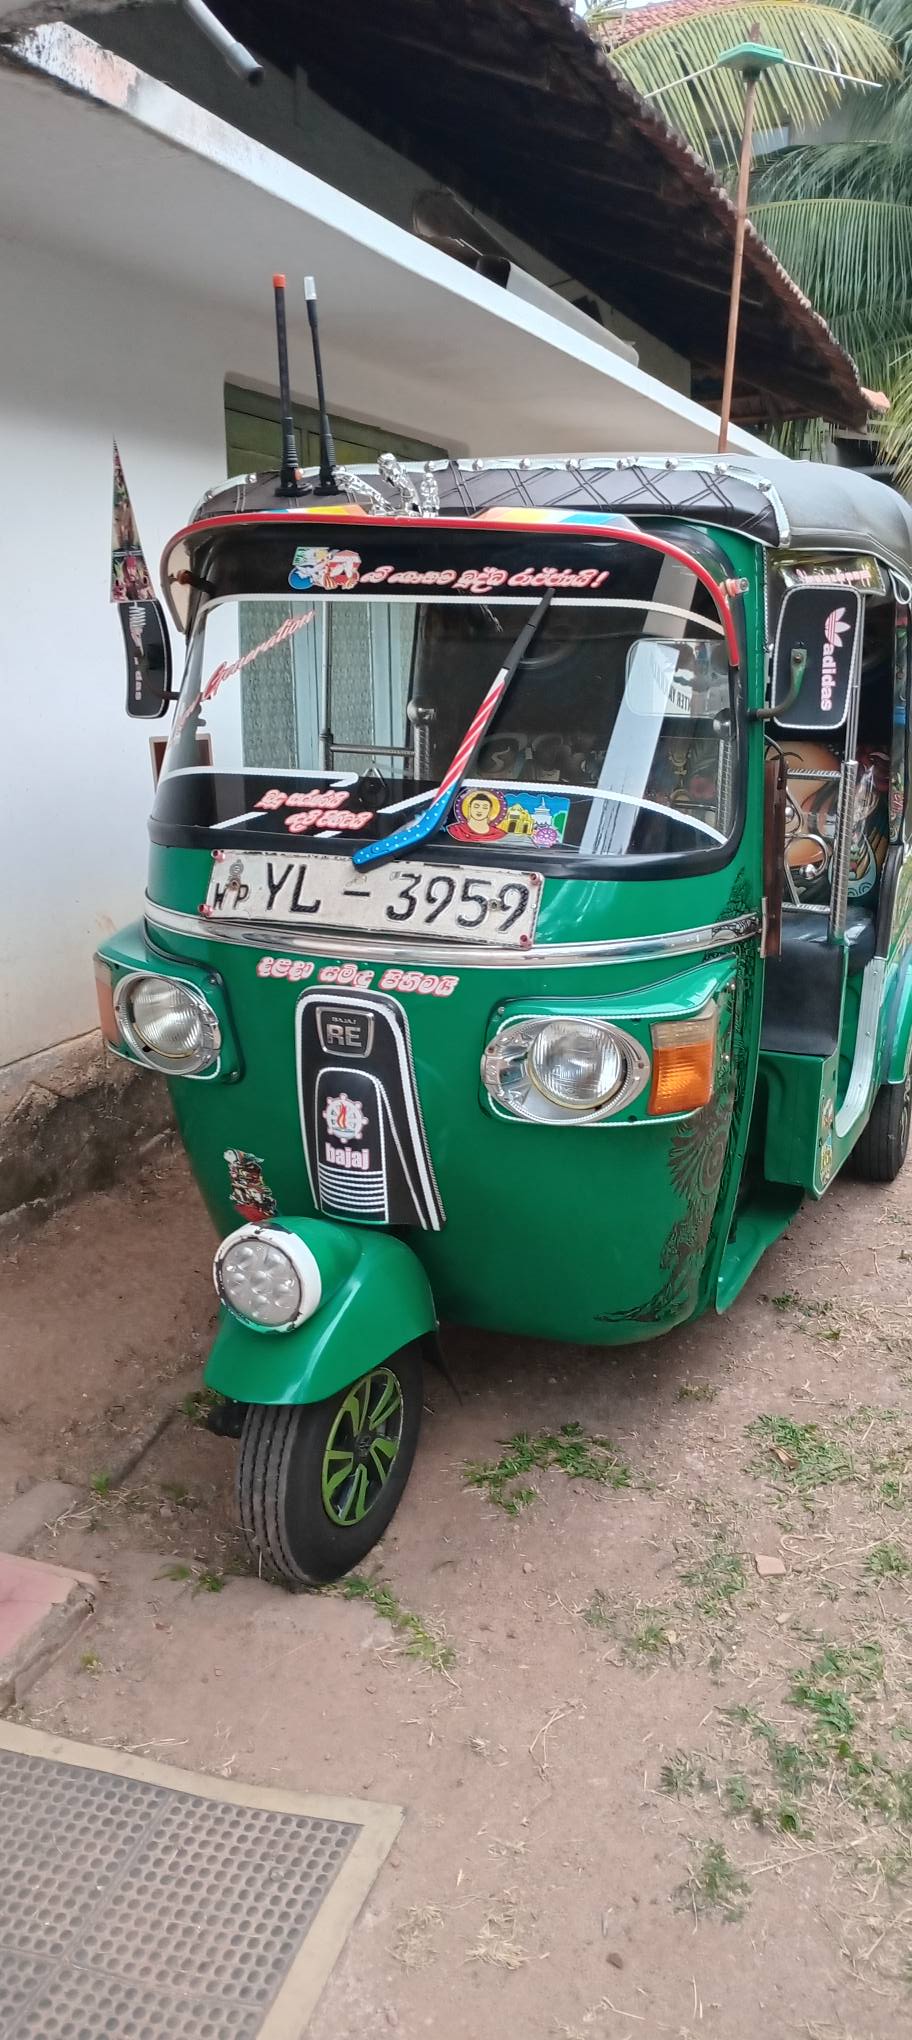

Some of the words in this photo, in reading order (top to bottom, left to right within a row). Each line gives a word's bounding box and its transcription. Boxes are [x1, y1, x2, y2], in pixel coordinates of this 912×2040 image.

[821, 643, 837, 711] adidas
[266, 862, 321, 914] YL
[385, 872, 531, 933] 3959
[326, 1023, 363, 1048] RE
[325, 1142, 370, 1170] bajaj
